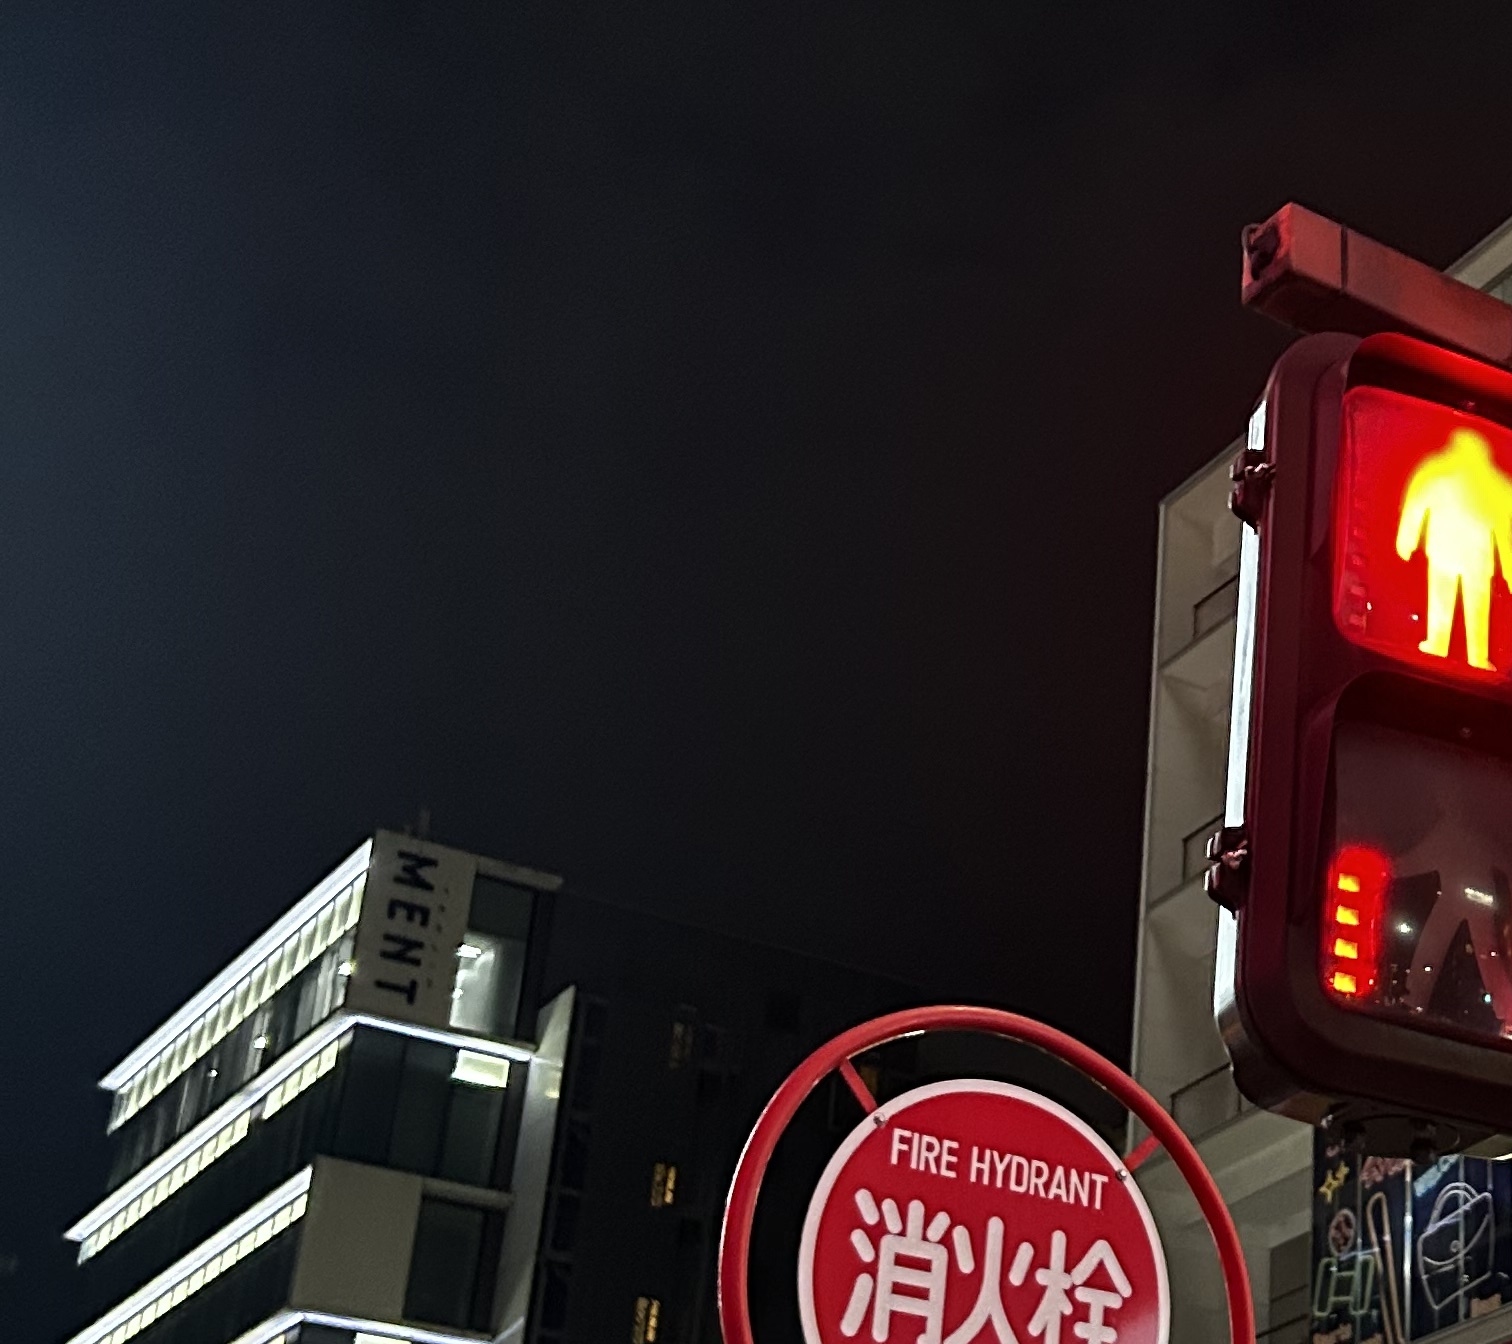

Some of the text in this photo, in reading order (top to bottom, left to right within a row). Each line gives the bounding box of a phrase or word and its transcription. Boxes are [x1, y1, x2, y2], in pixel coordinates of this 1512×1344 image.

[374, 850, 438, 1004] MENT
[891, 1128, 1108, 1209] FIRE HYDRANT
